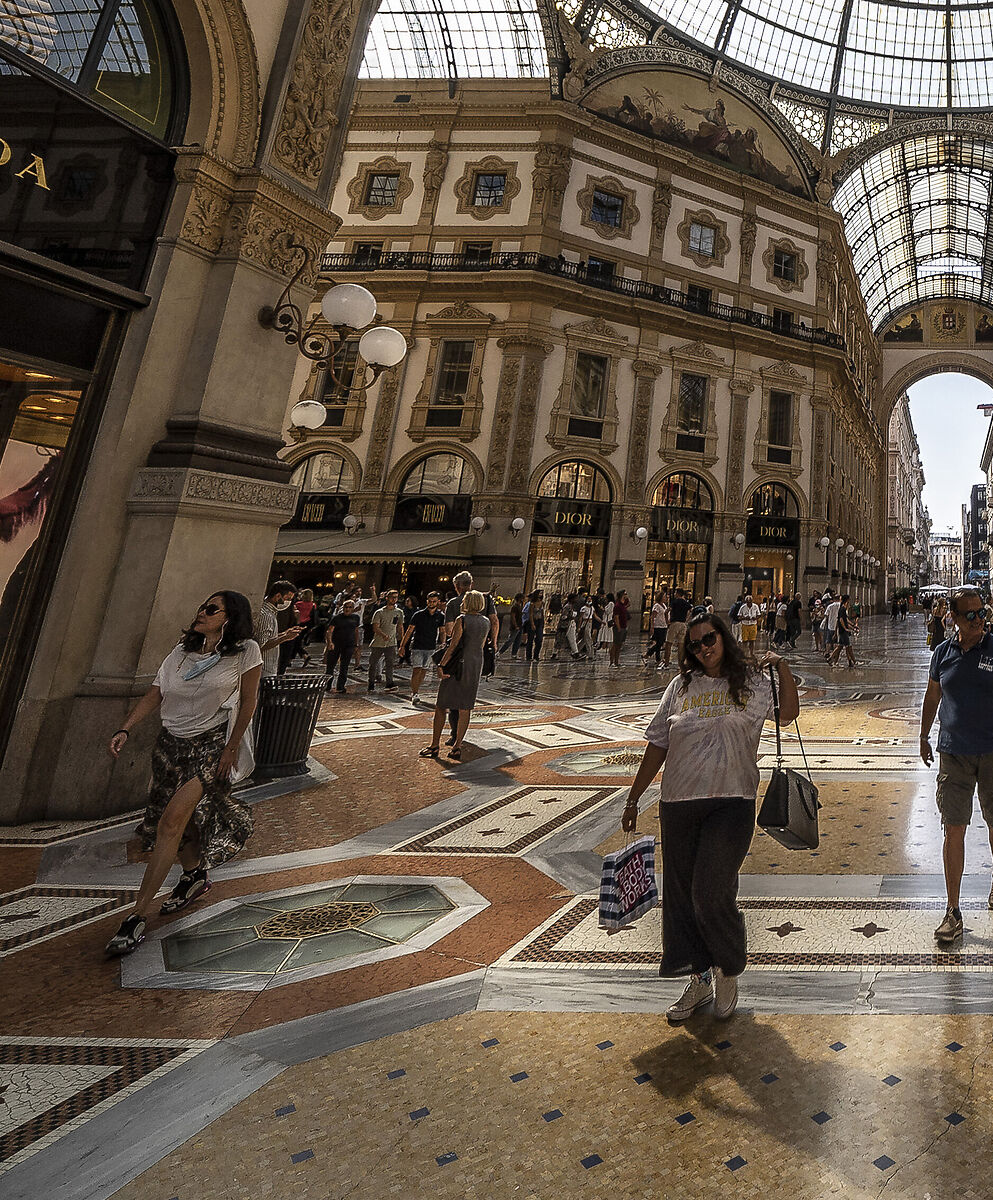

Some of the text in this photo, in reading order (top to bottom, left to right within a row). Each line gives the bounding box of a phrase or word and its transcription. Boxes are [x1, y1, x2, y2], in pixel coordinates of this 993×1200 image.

[555, 511, 592, 526] DIOR
[666, 519, 698, 531] DIOR
[760, 526, 787, 538] DIOR
[623, 860, 646, 894] BODY
